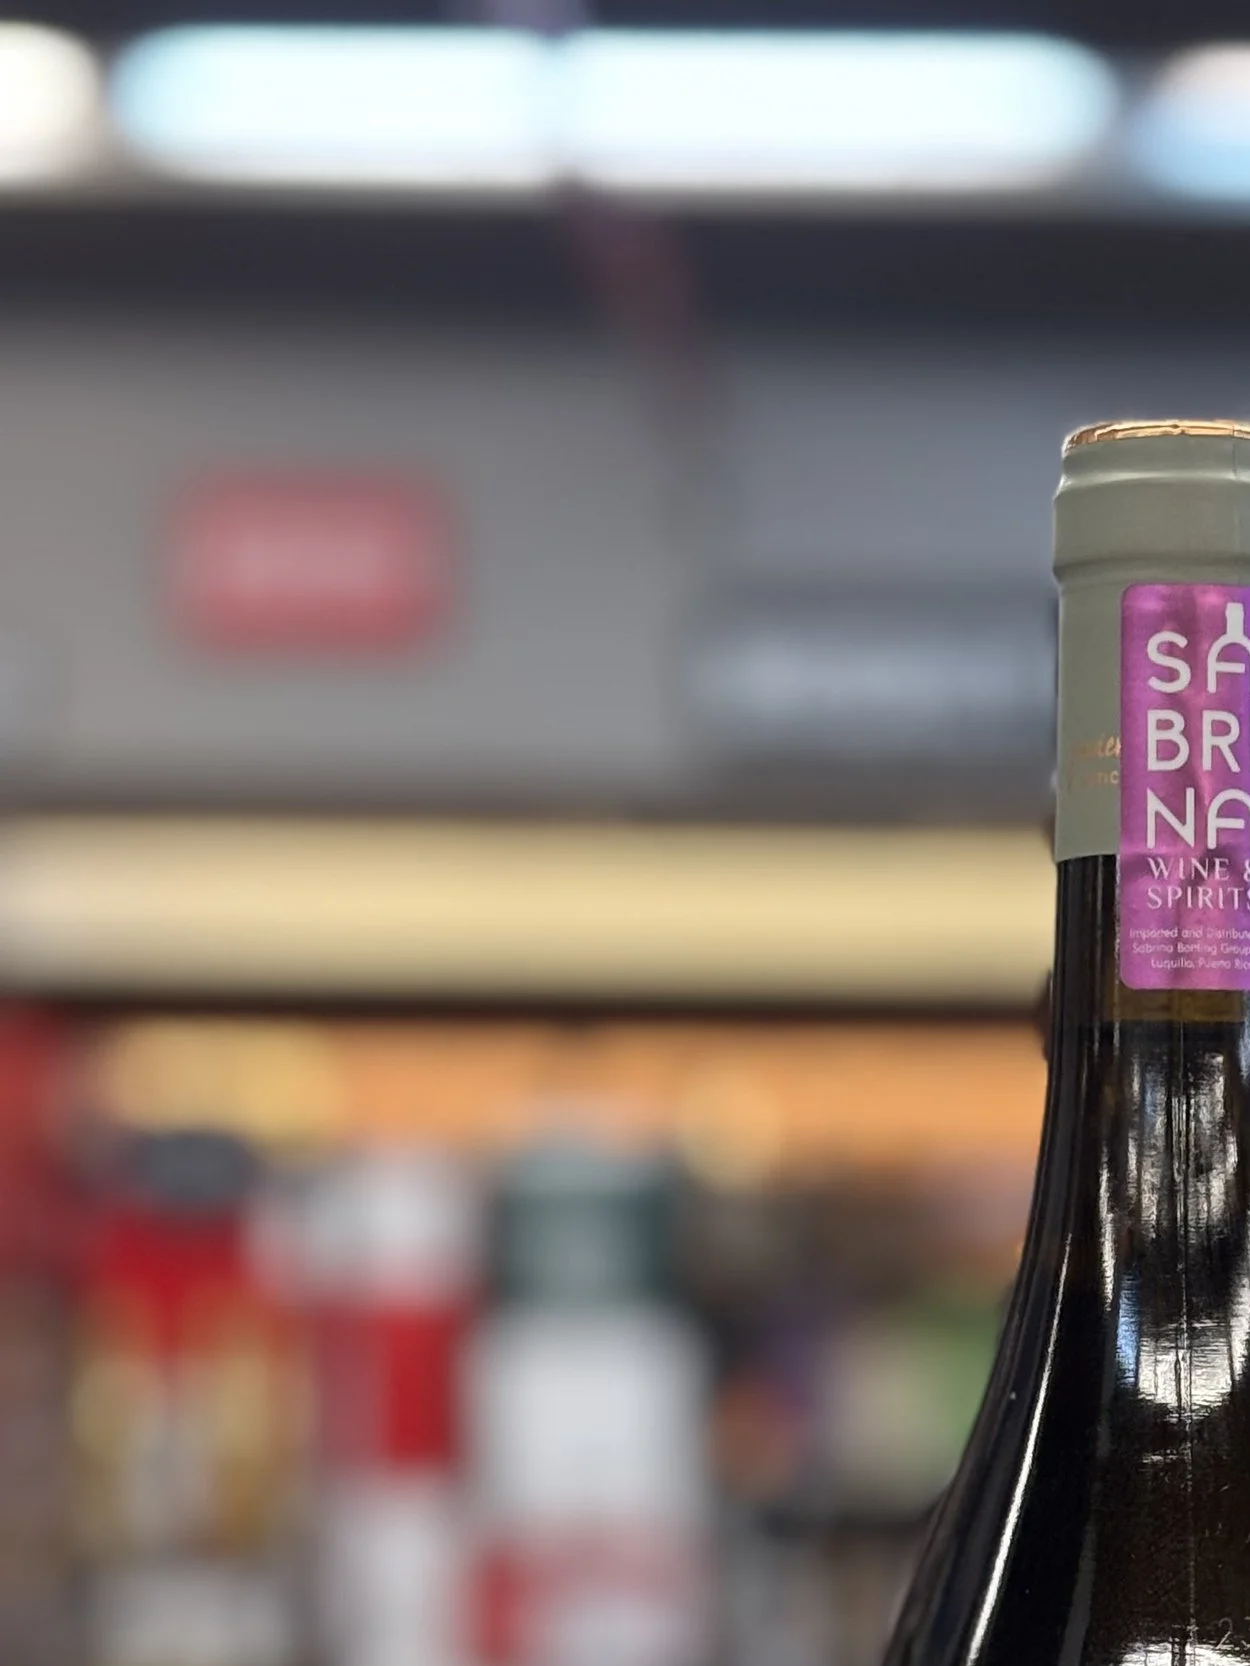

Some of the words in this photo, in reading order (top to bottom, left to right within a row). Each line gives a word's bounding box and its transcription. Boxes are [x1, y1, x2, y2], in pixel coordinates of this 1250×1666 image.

[1147, 857, 1230, 881] WINE
[1130, 927, 1178, 940] Imported
[1181, 926, 1202, 938] and
